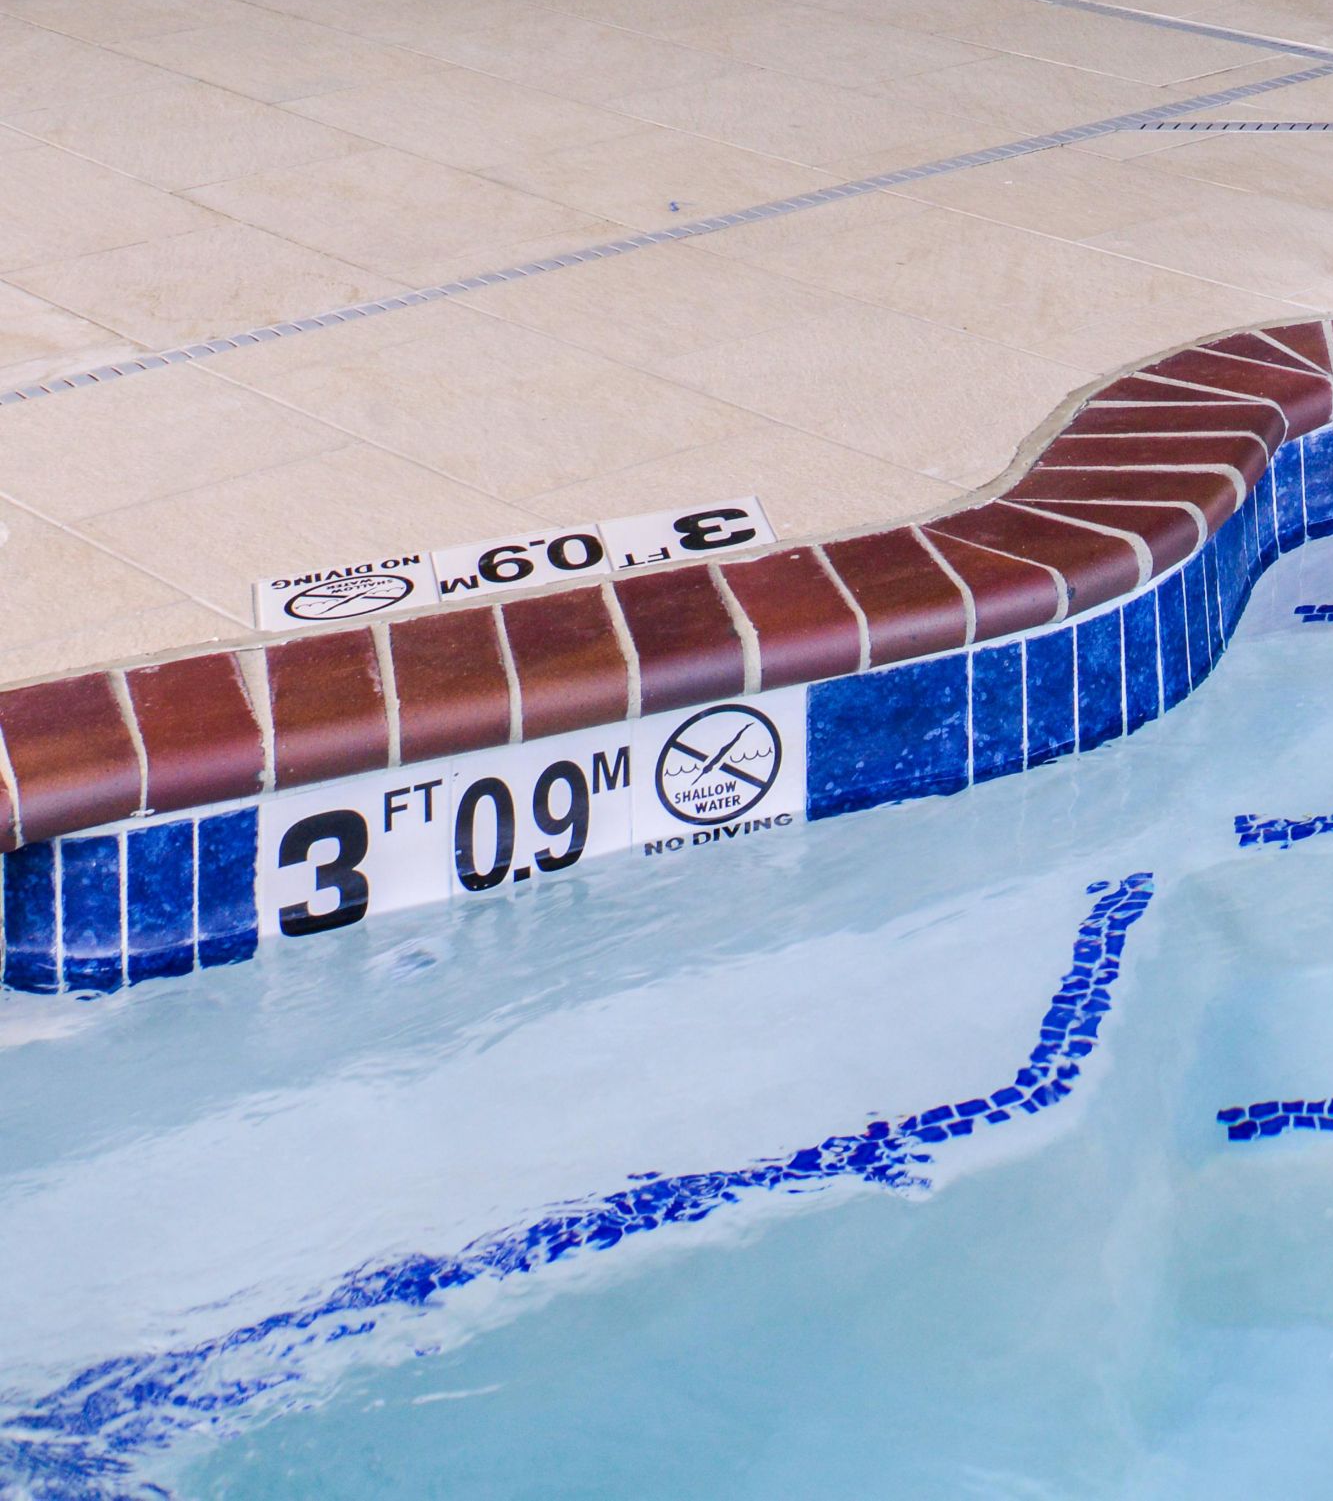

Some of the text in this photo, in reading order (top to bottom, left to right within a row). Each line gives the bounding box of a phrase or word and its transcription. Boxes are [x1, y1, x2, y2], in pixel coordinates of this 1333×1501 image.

[673, 508, 756, 551] 3
[619, 547, 671, 569] FT
[271, 555, 420, 589] NO DIVING
[326, 578, 372, 590] WATER
[332, 579, 393, 594] SHALLOW
[674, 780, 737, 804] SHALLOW
[695, 794, 741, 814] WATER
[644, 813, 793, 856] NO DIVING
[279, 809, 369, 937] 3
[384, 778, 443, 833] FT
